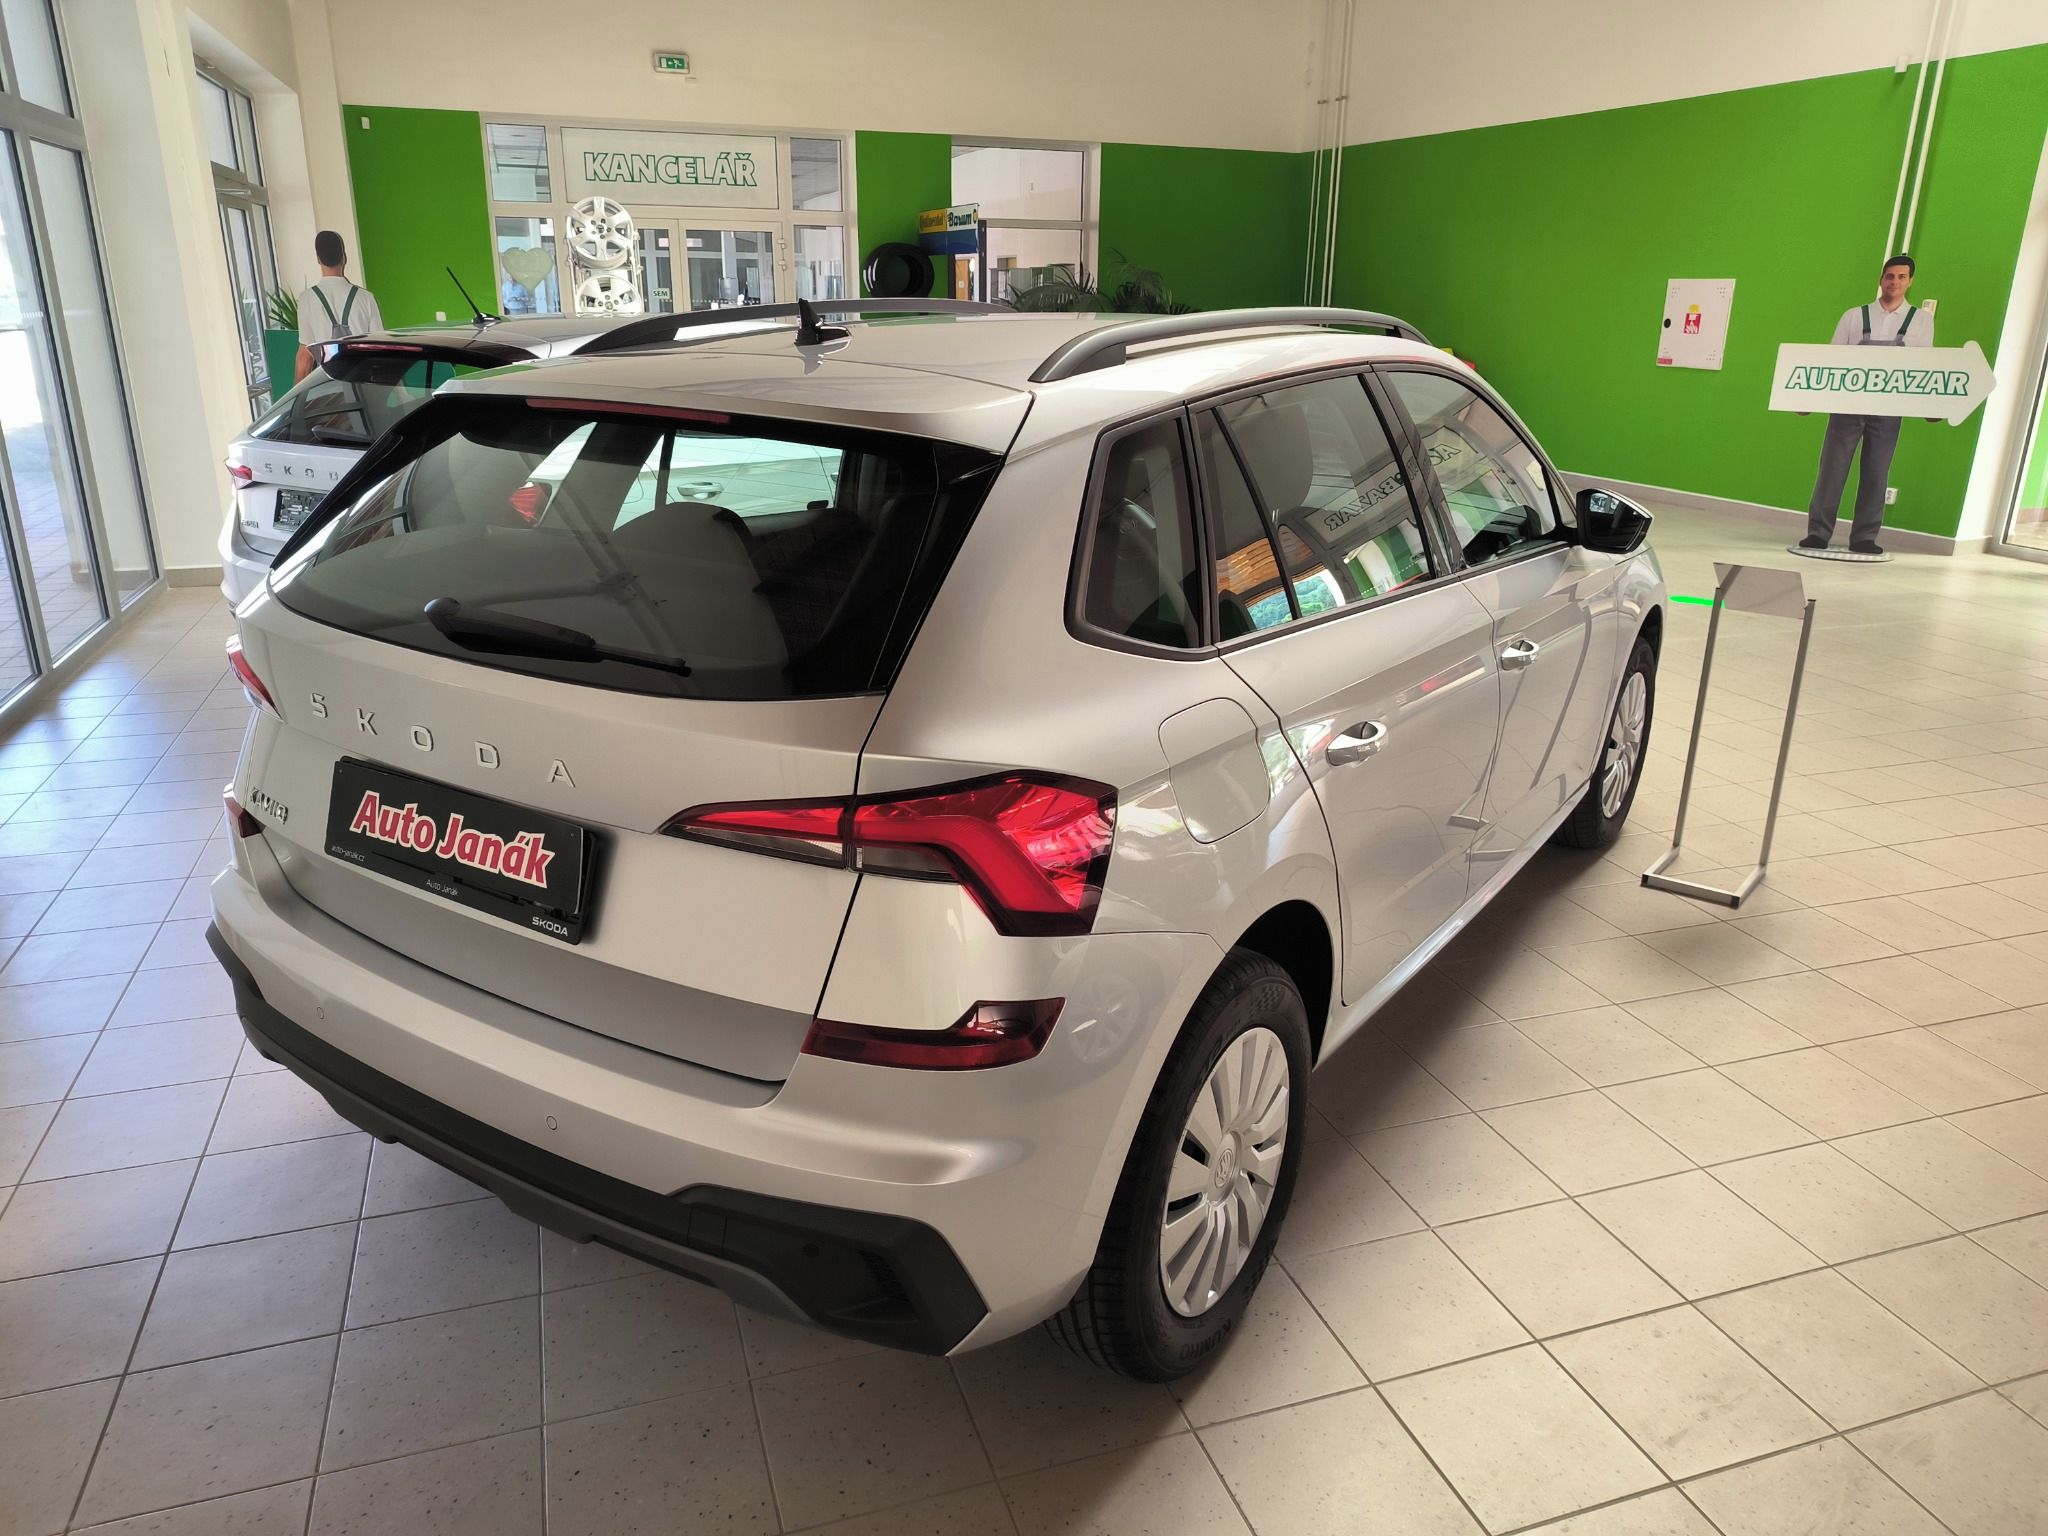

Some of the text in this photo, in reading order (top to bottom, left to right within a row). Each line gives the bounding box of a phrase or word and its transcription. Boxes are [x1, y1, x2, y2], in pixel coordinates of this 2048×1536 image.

[583, 150, 758, 188] KANCELÁŘ
[948, 211, 972, 227] Barum
[652, 289, 669, 298] SEM
[1784, 365, 1970, 397] AUTOBAZAR
[310, 691, 577, 789] SKODA
[349, 789, 556, 889] Auto Janák
[426, 879, 441, 891] Auto
[531, 915, 569, 937] SKODA
